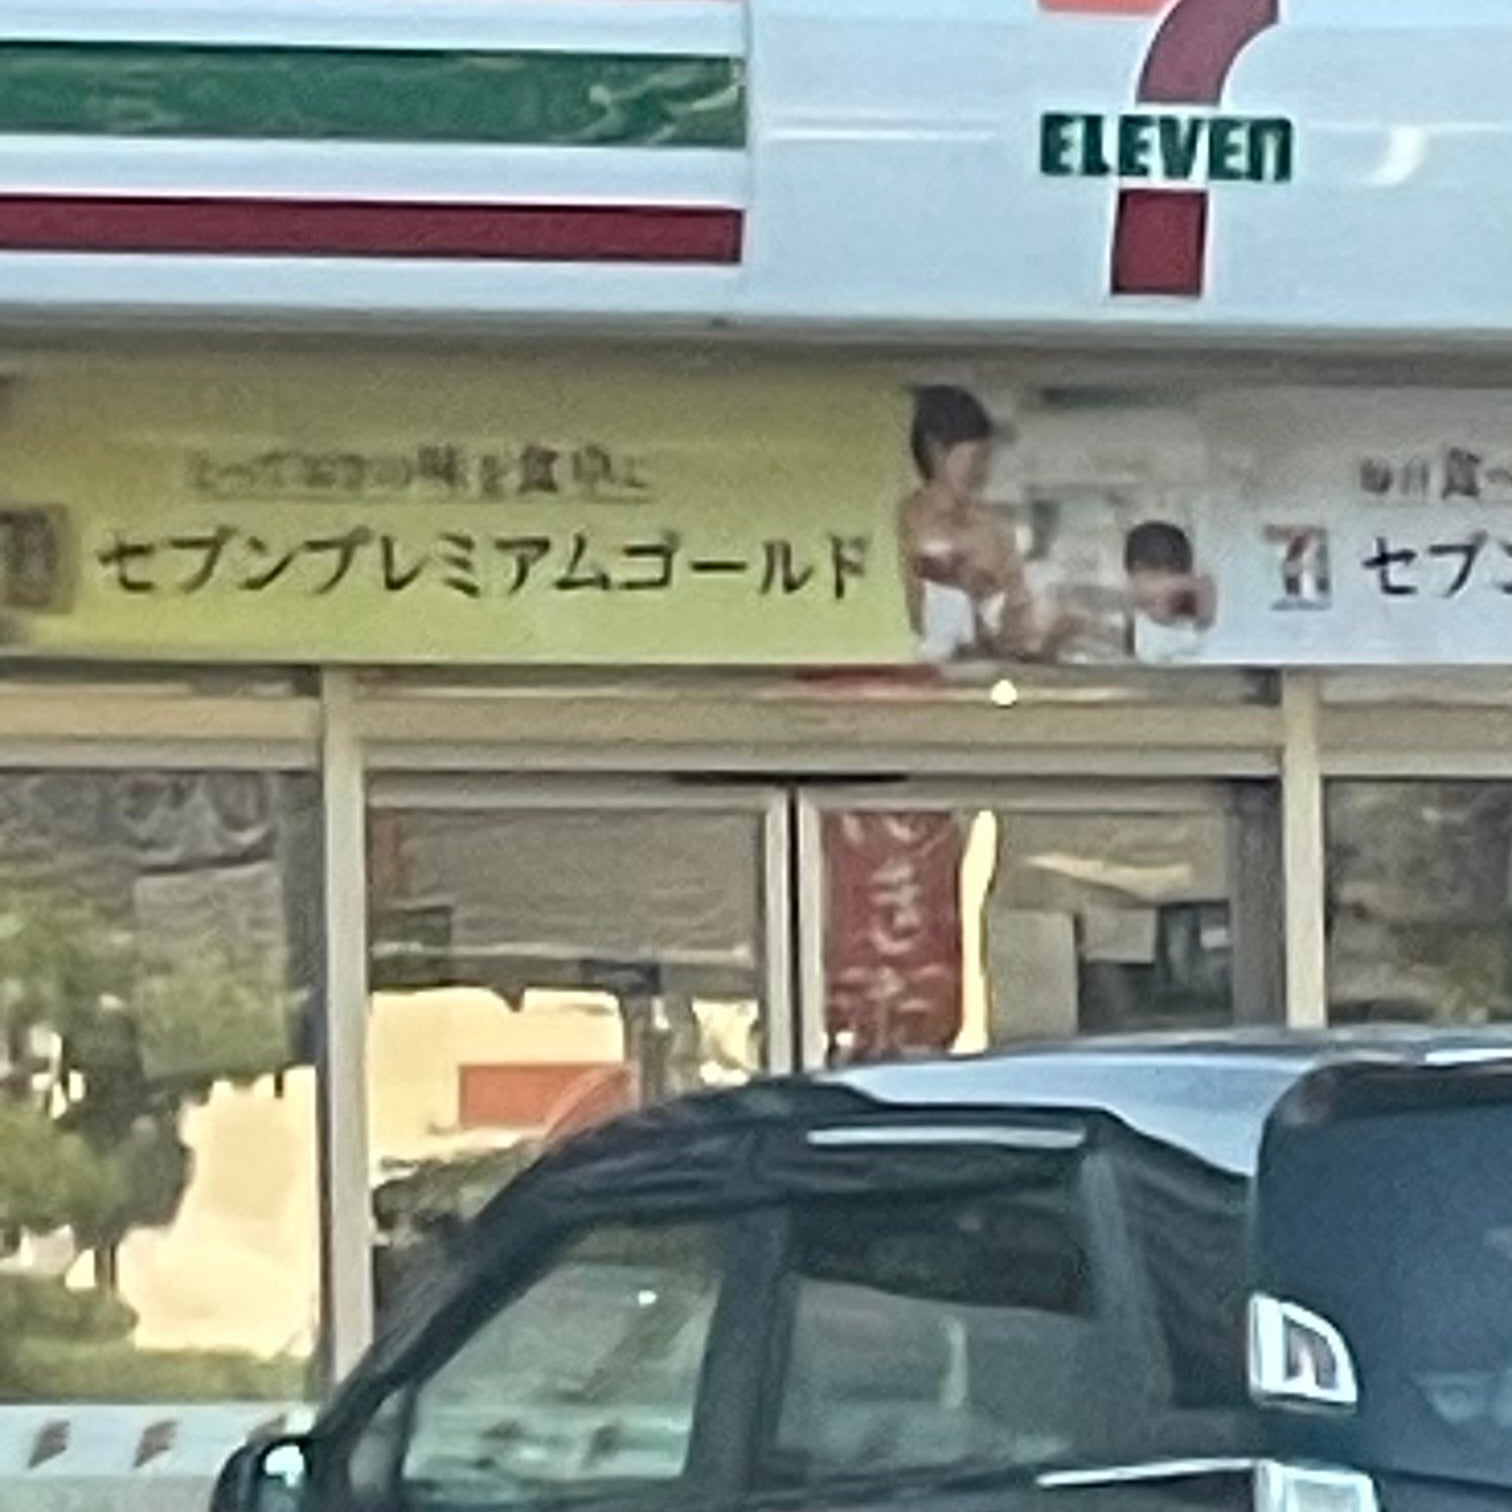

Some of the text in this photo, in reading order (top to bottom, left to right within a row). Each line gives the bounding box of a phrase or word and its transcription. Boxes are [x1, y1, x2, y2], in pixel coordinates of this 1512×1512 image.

[97, 524, 870, 600] セブンプレミアムゴールド
